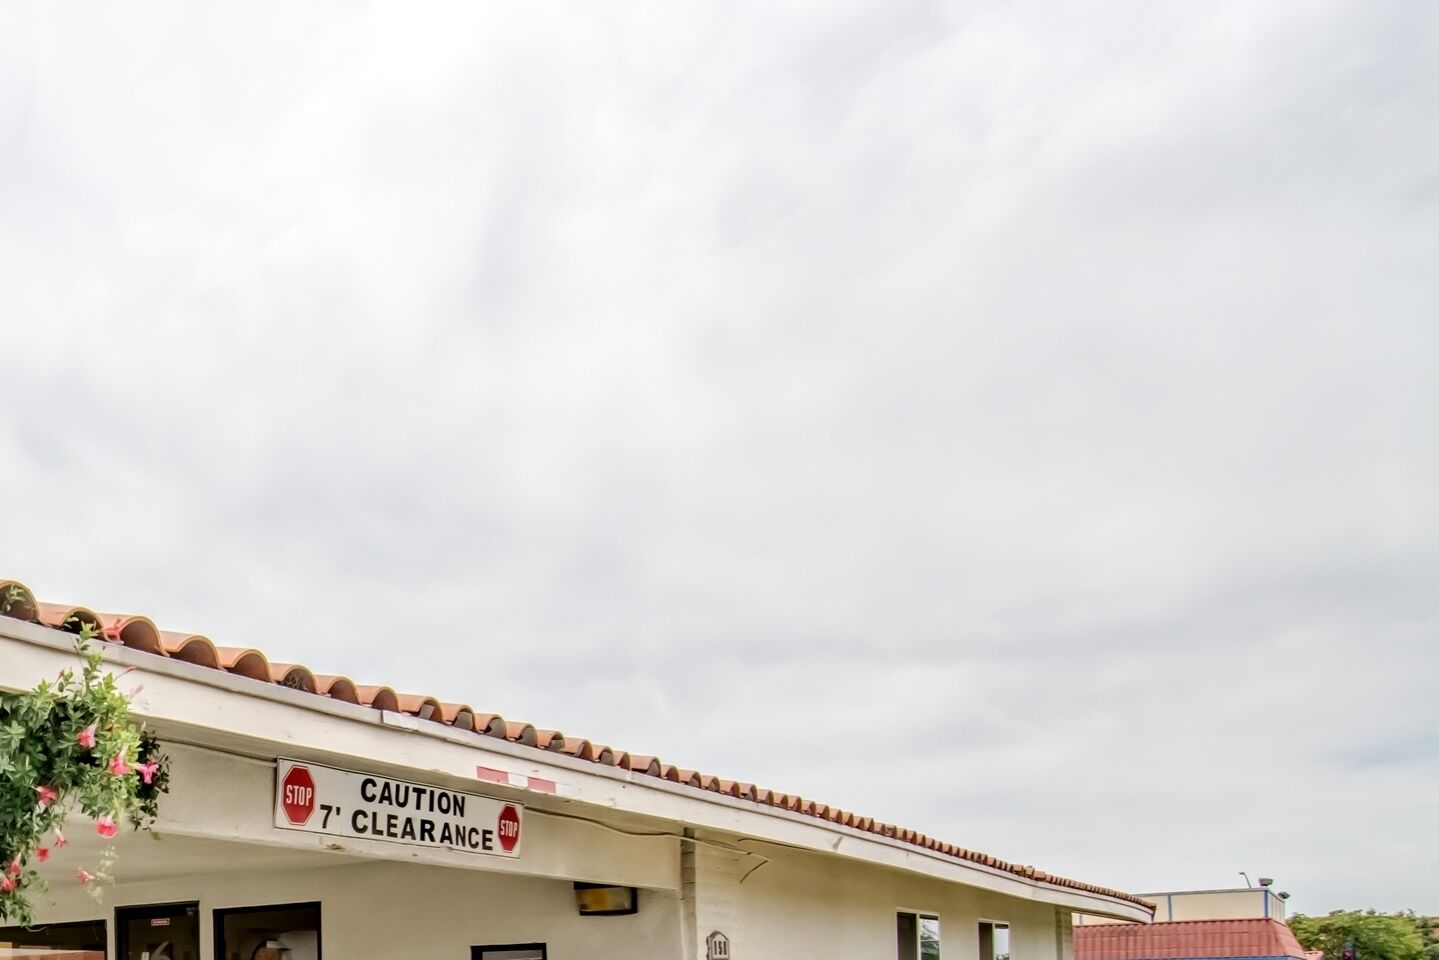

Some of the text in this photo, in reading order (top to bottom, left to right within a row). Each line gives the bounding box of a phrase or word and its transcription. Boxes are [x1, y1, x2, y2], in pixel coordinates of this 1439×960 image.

[286, 784, 312, 806] STOP
[360, 777, 465, 818] CAUTION
[320, 804, 494, 851] 7' CLEARANCE
[500, 820, 518, 838] STOP
